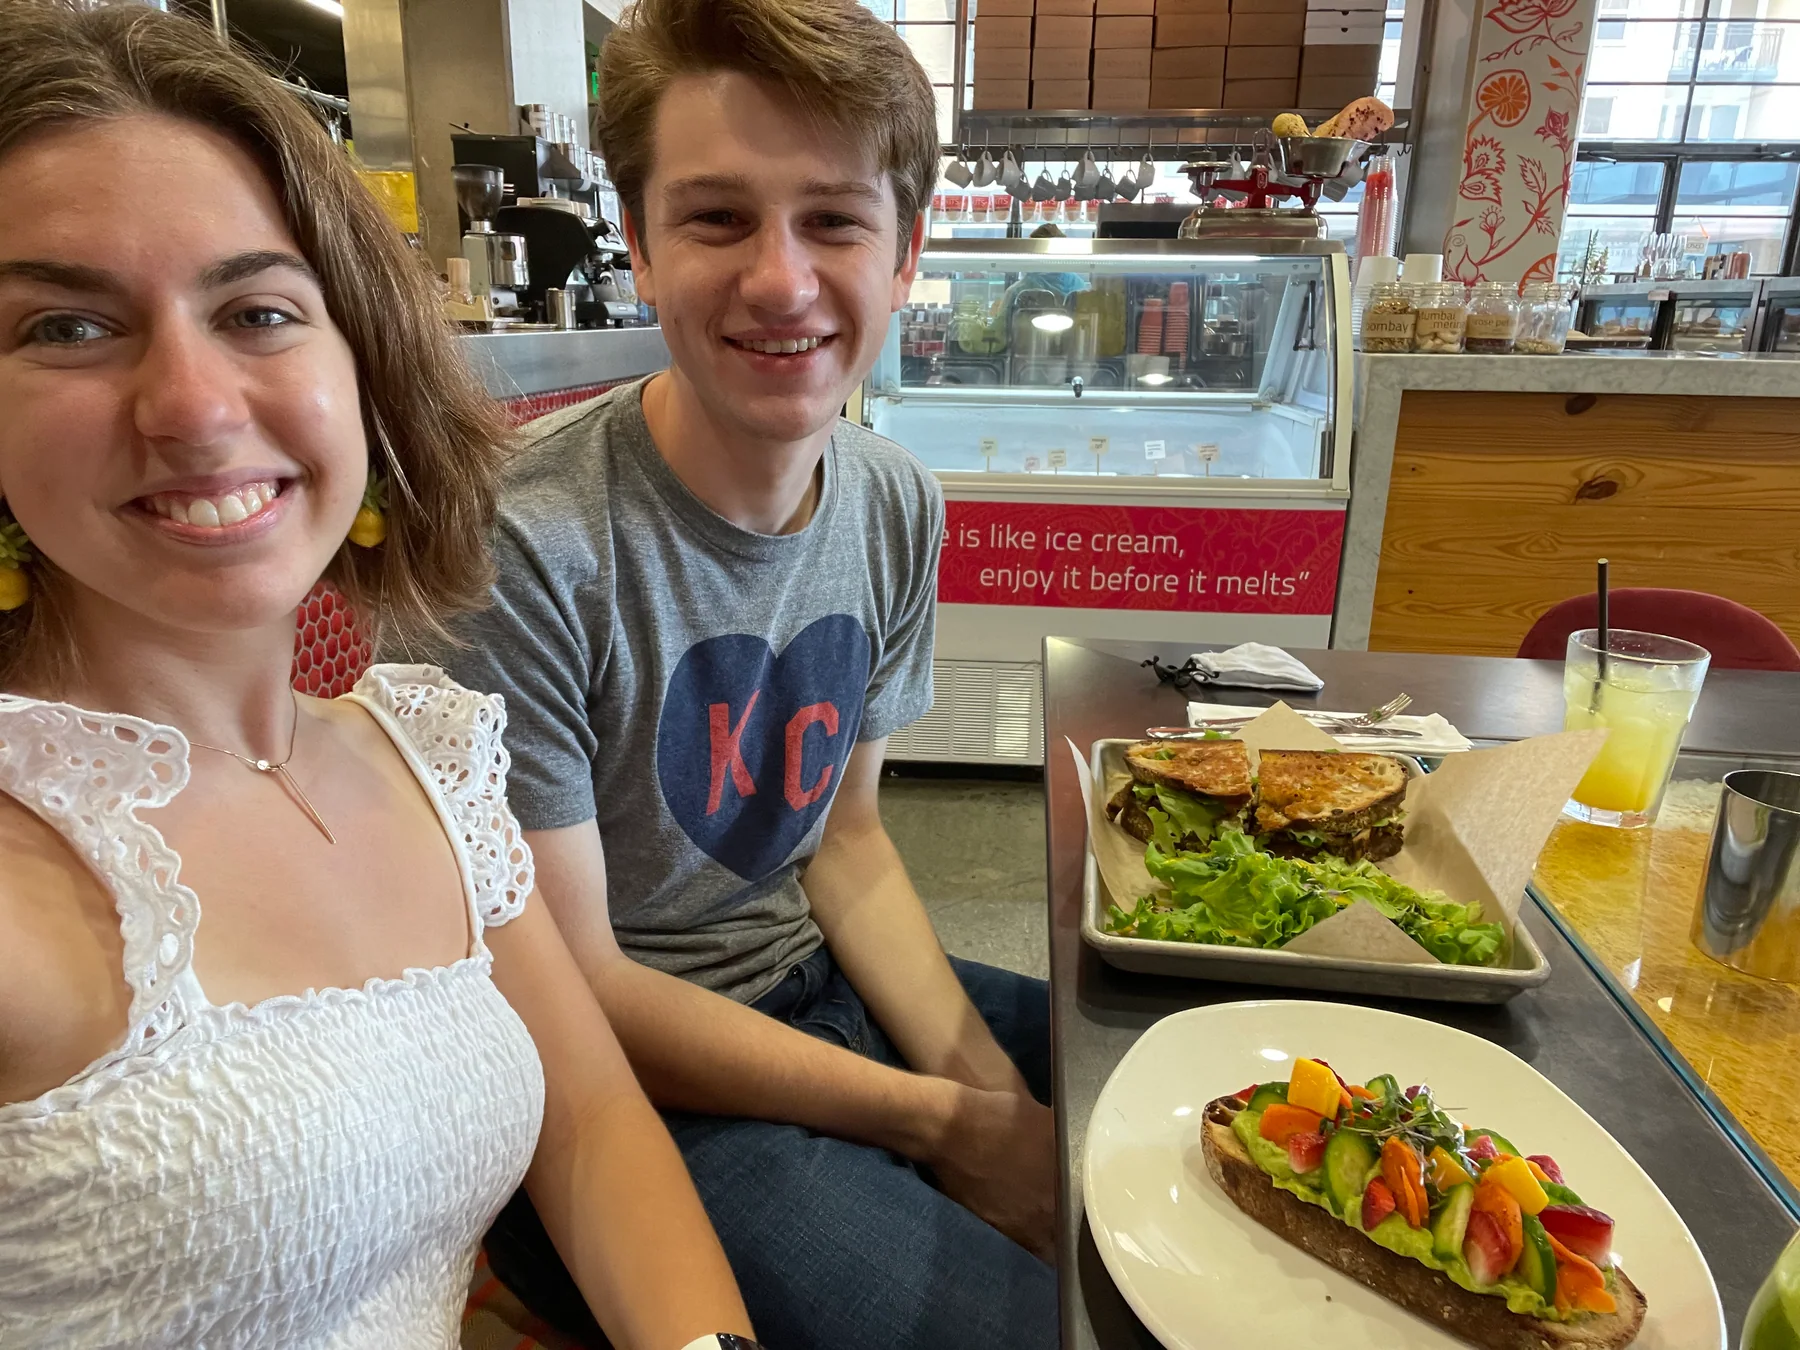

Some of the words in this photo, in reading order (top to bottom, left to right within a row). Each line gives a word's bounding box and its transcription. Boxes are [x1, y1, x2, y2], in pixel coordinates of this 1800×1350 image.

[959, 523, 980, 549] is
[989, 523, 1036, 551] like
[1045, 524, 1082, 552] ice
[1090, 529, 1186, 559] cream,
[978, 562, 1053, 596] enjoy
[1063, 563, 1082, 591] it
[1090, 565, 1179, 594] before
[1187, 567, 1207, 595] it
[706, 688, 840, 816] KC
